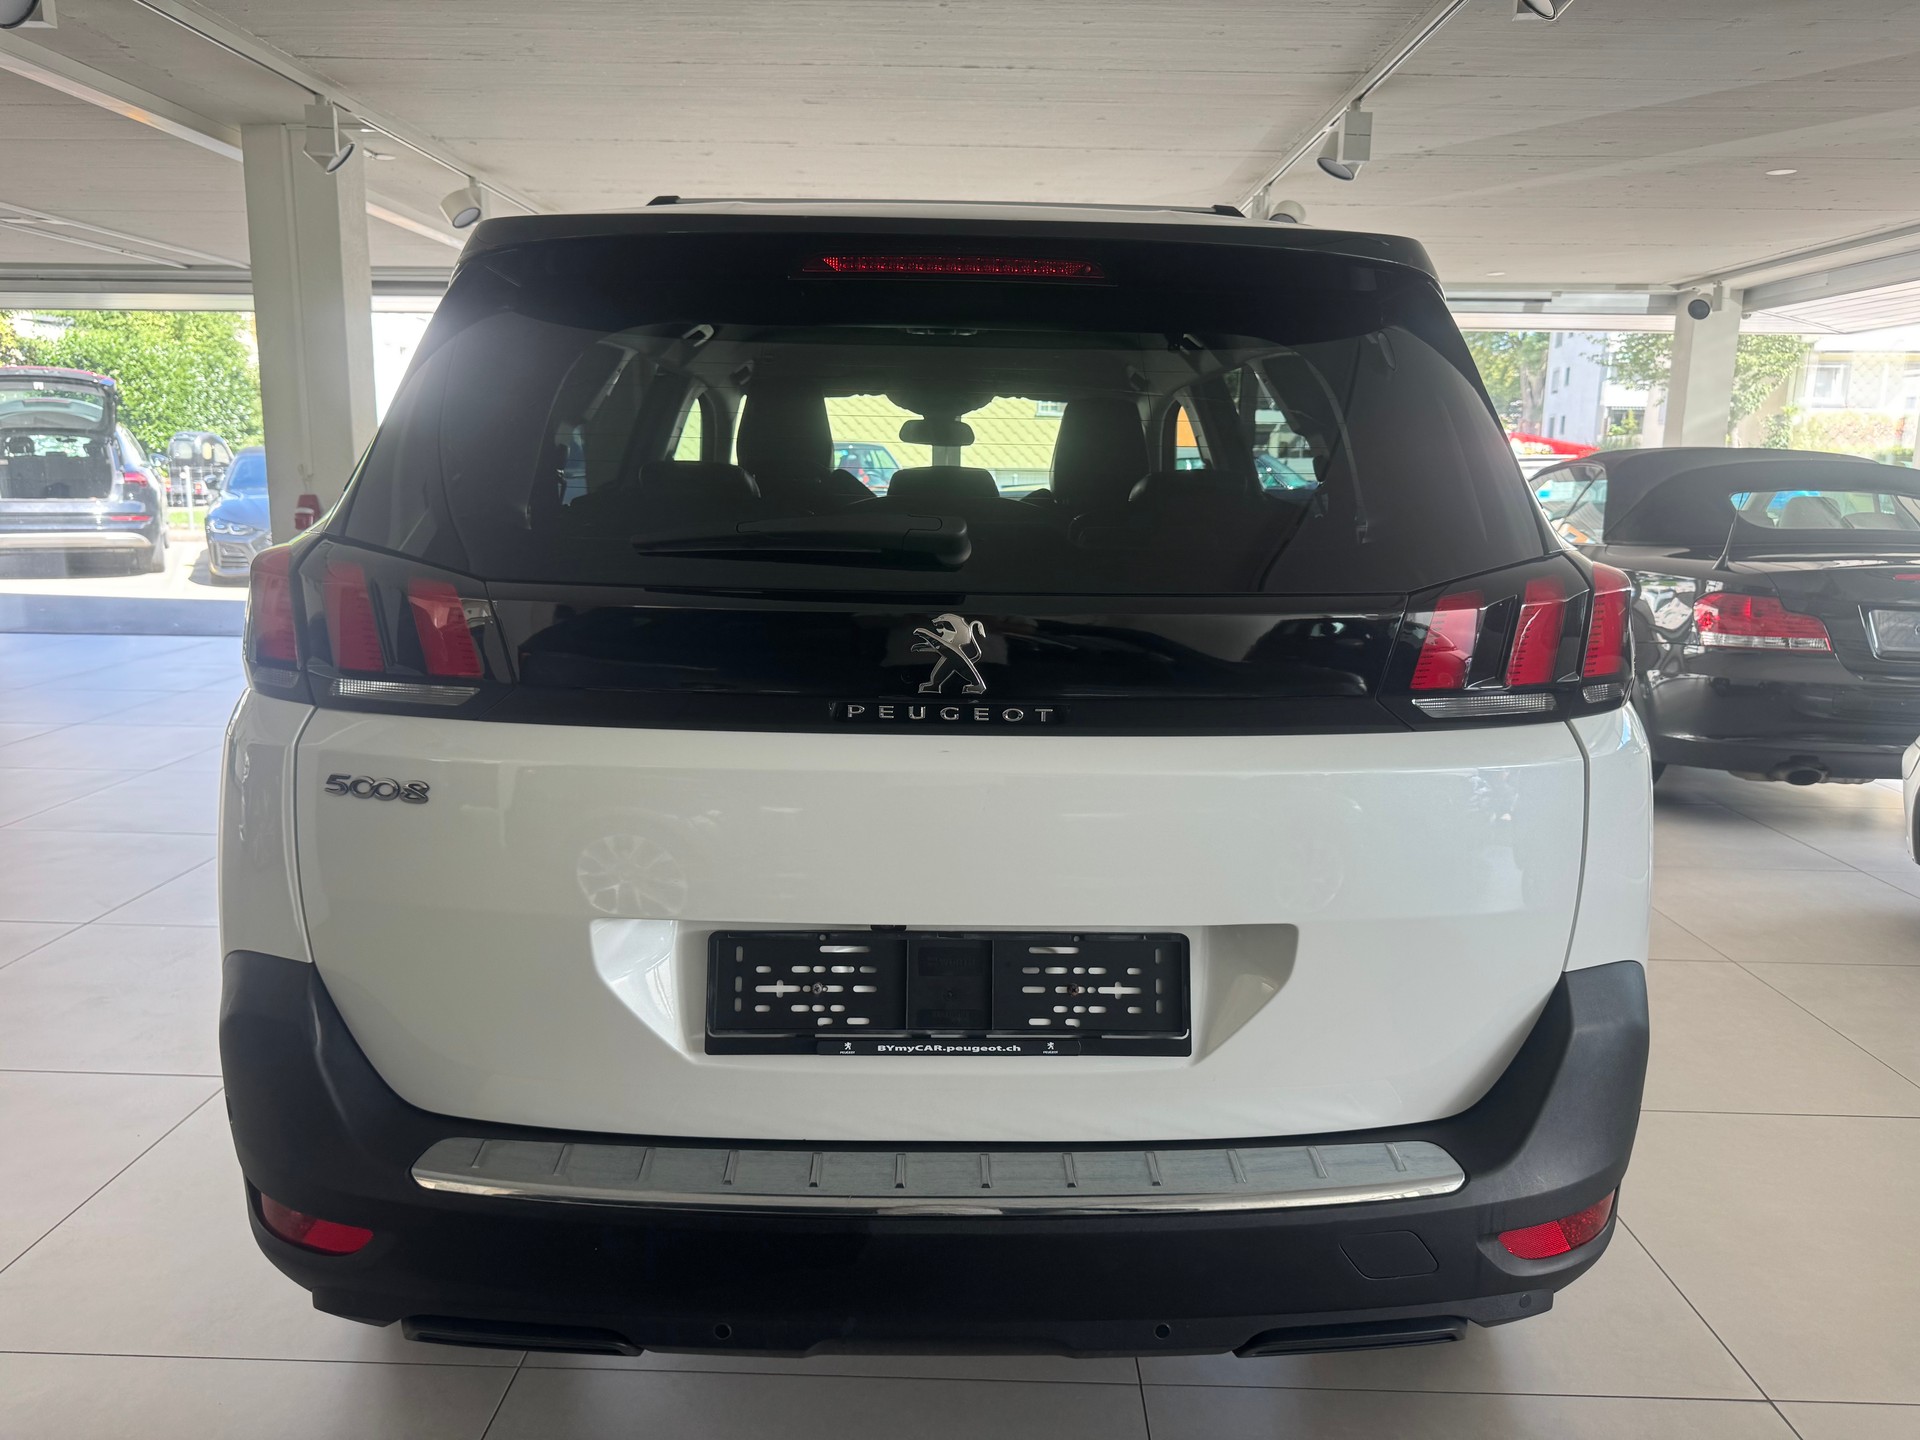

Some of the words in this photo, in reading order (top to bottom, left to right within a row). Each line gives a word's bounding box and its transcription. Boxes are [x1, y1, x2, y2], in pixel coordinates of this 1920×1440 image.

[847, 704, 1054, 722] PEUGEOT
[324, 773, 430, 804] 5008
[877, 1044, 1021, 1053] BYmyCAR.peugeot.ch
